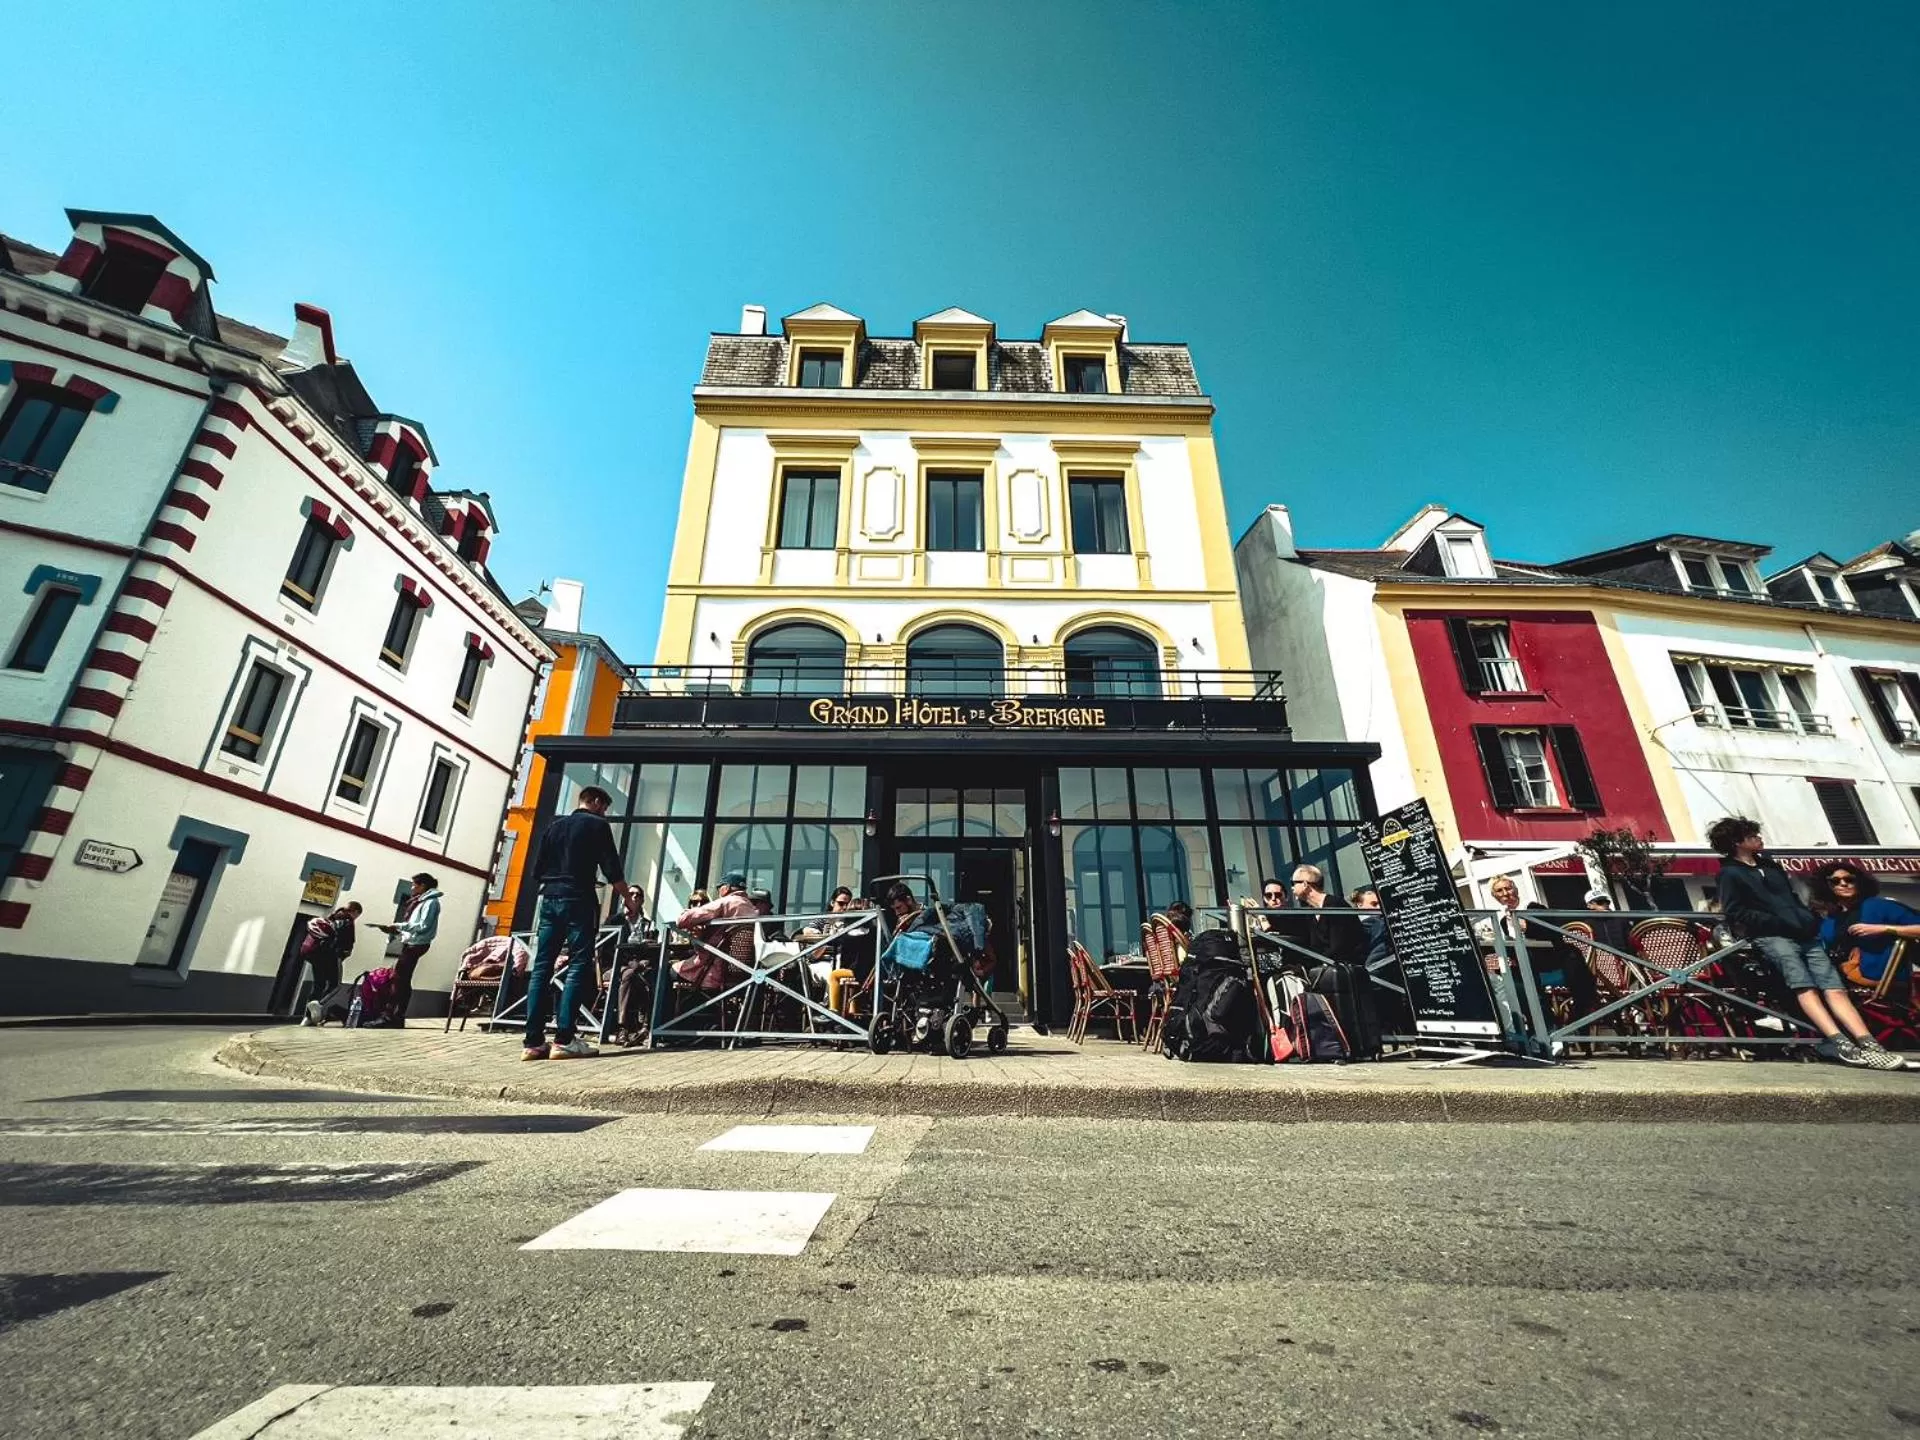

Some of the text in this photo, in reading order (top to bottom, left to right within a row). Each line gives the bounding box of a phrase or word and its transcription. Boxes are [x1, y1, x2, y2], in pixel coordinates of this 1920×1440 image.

[809, 698, 889, 724] GRAND
[970, 709, 985, 719] DE
[988, 699, 1106, 726] BRETAGNE
